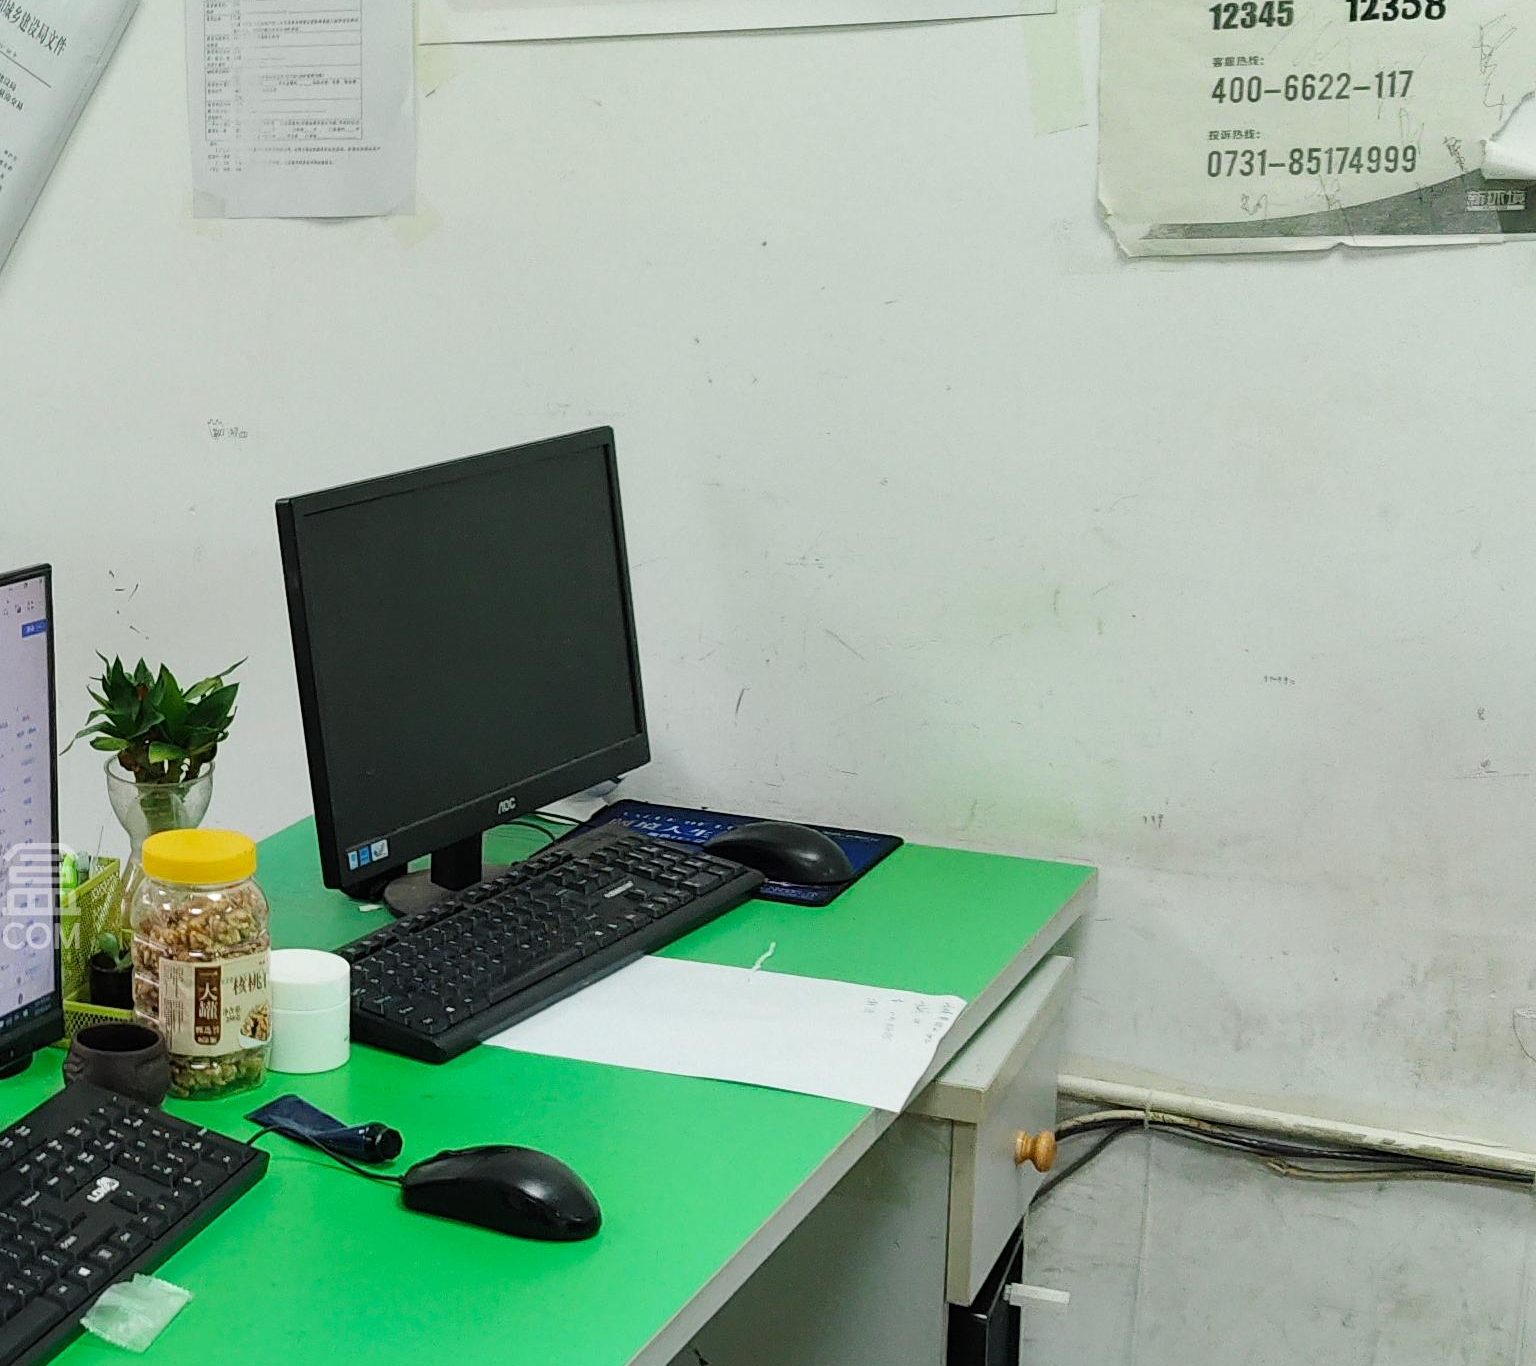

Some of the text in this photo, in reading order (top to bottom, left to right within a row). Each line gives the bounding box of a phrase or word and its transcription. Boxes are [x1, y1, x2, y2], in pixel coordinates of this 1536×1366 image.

[1209, 0, 1294, 30] 12345
[1211, 70, 1414, 104] 400-6622-117
[1206, 145, 1417, 178] 0731-85174999
[1466, 188, 1526, 209] 新环境
[497, 797, 517, 815] AOC
